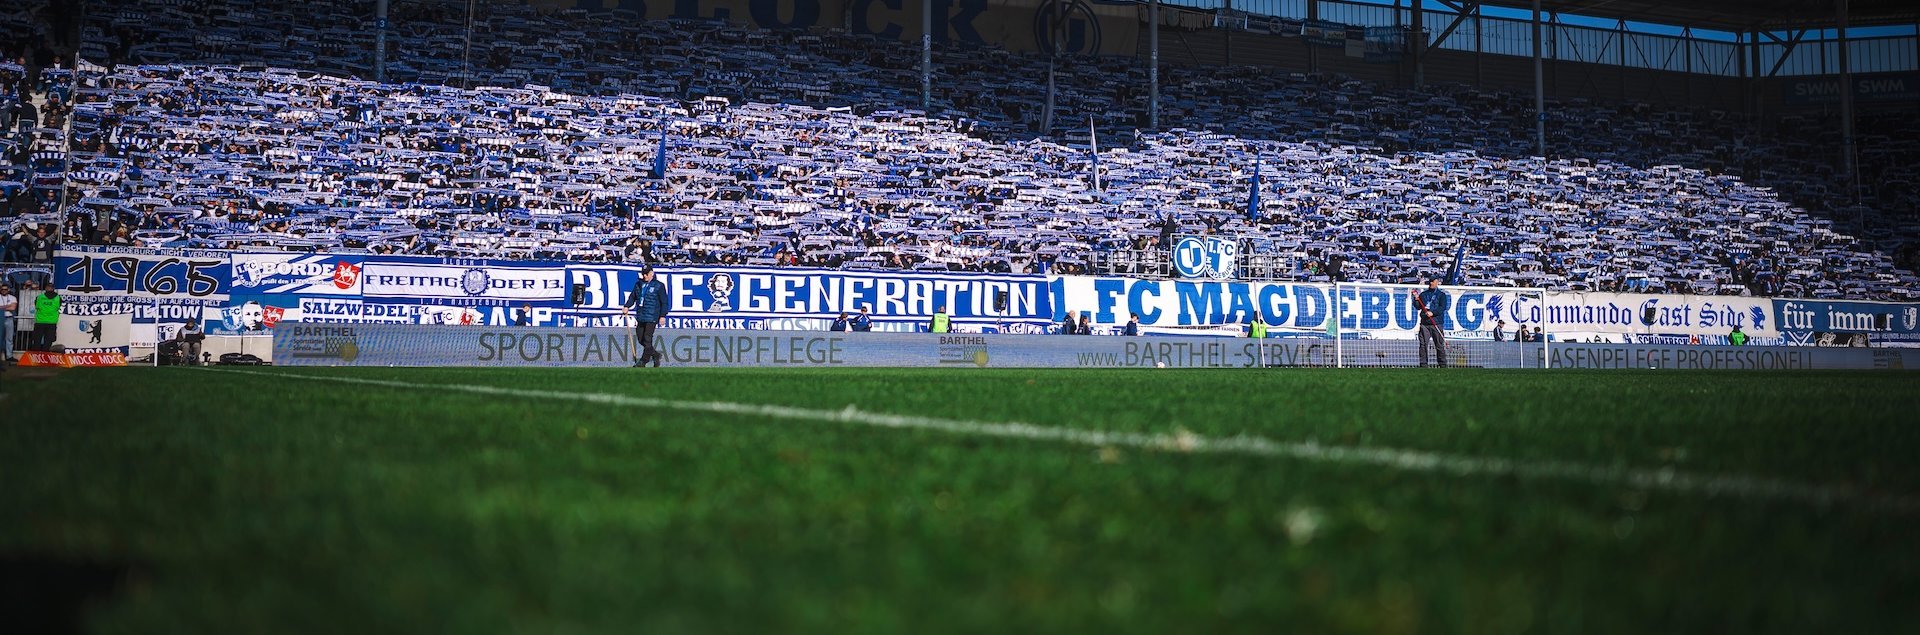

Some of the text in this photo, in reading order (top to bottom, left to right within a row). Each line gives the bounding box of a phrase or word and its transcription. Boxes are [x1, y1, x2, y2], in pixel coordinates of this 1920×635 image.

[379, 19, 386, 28] 3
[1858, 79, 1905, 93] SWM
[60, 244, 82, 252] NOCH
[106, 247, 156, 256] MAGDEBURG
[160, 249, 185, 257] NICHT
[188, 250, 229, 259] VERLOREN
[261, 257, 335, 276] BÖRDE
[442, 258, 474, 266] BLOCK
[66, 255, 222, 297] 1965
[365, 275, 565, 289] FREITAG DER 13.
[571, 269, 1036, 316] BLE GENERATION
[185, 298, 200, 306] DER
[302, 301, 408, 317] SALZWEDEL
[1510, 294, 1632, 325] Commando
[1699, 302, 1745, 328] Side
[1782, 301, 1893, 332] für immr
[694, 318, 746, 330] BEZIRK
[293, 326, 357, 337] BARTHEL
[940, 336, 987, 345] BARTHEL
[478, 332, 844, 365] SPORTANAGENPFLEGE
[30, 353, 65, 365] MDCC MDCC
[69, 354, 125, 365] MDCC MDCC
